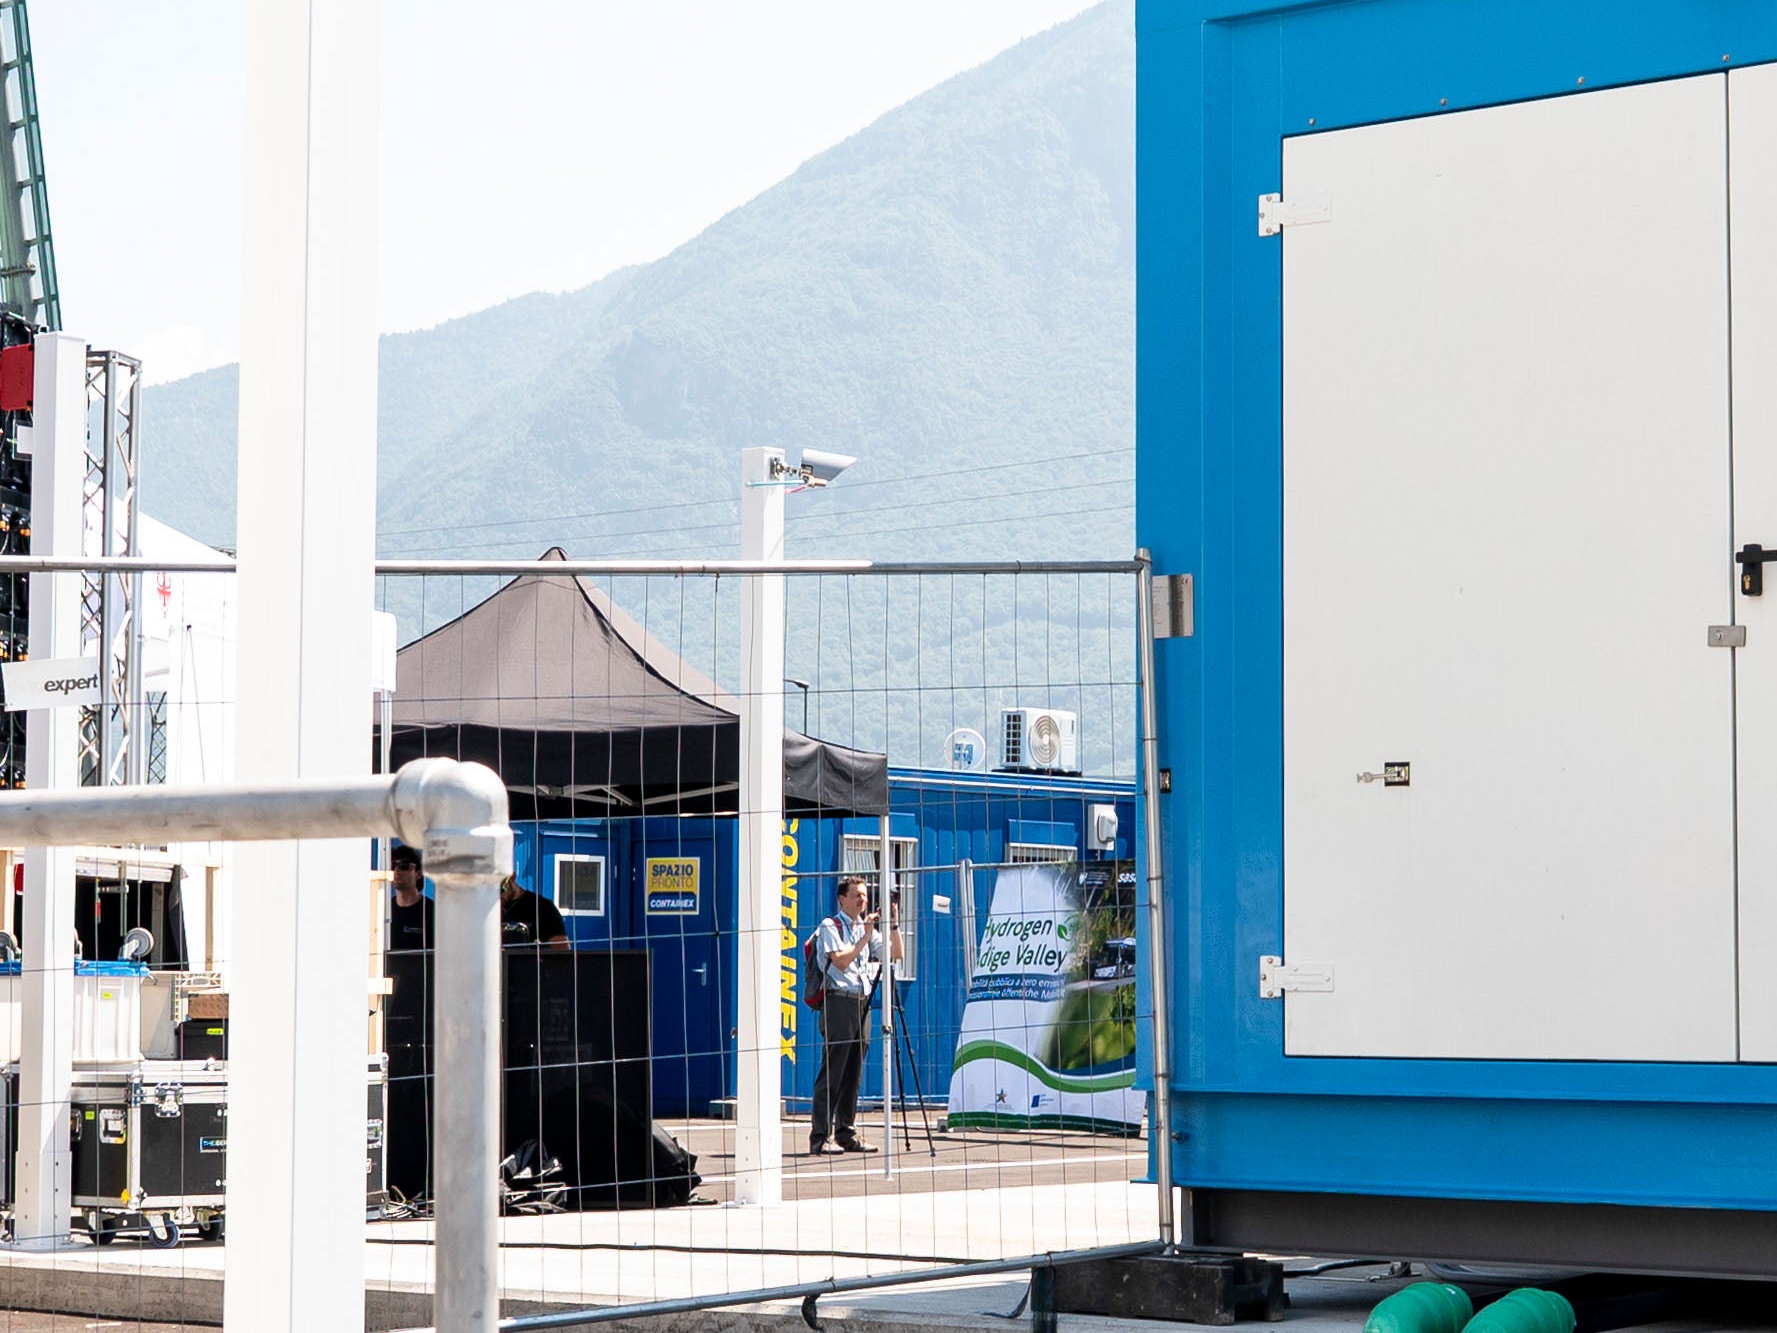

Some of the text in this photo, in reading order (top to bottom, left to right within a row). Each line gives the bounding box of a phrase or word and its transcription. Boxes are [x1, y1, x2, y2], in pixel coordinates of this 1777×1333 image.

[44, 673, 98, 695] expert
[652, 864, 694, 877] SPAZIO
[651, 877, 694, 888] PRONTO
[1117, 873, 1137, 884] sas
[650, 899, 694, 908] CONTAINEX
[976, 943, 1069, 973] dige Valley
